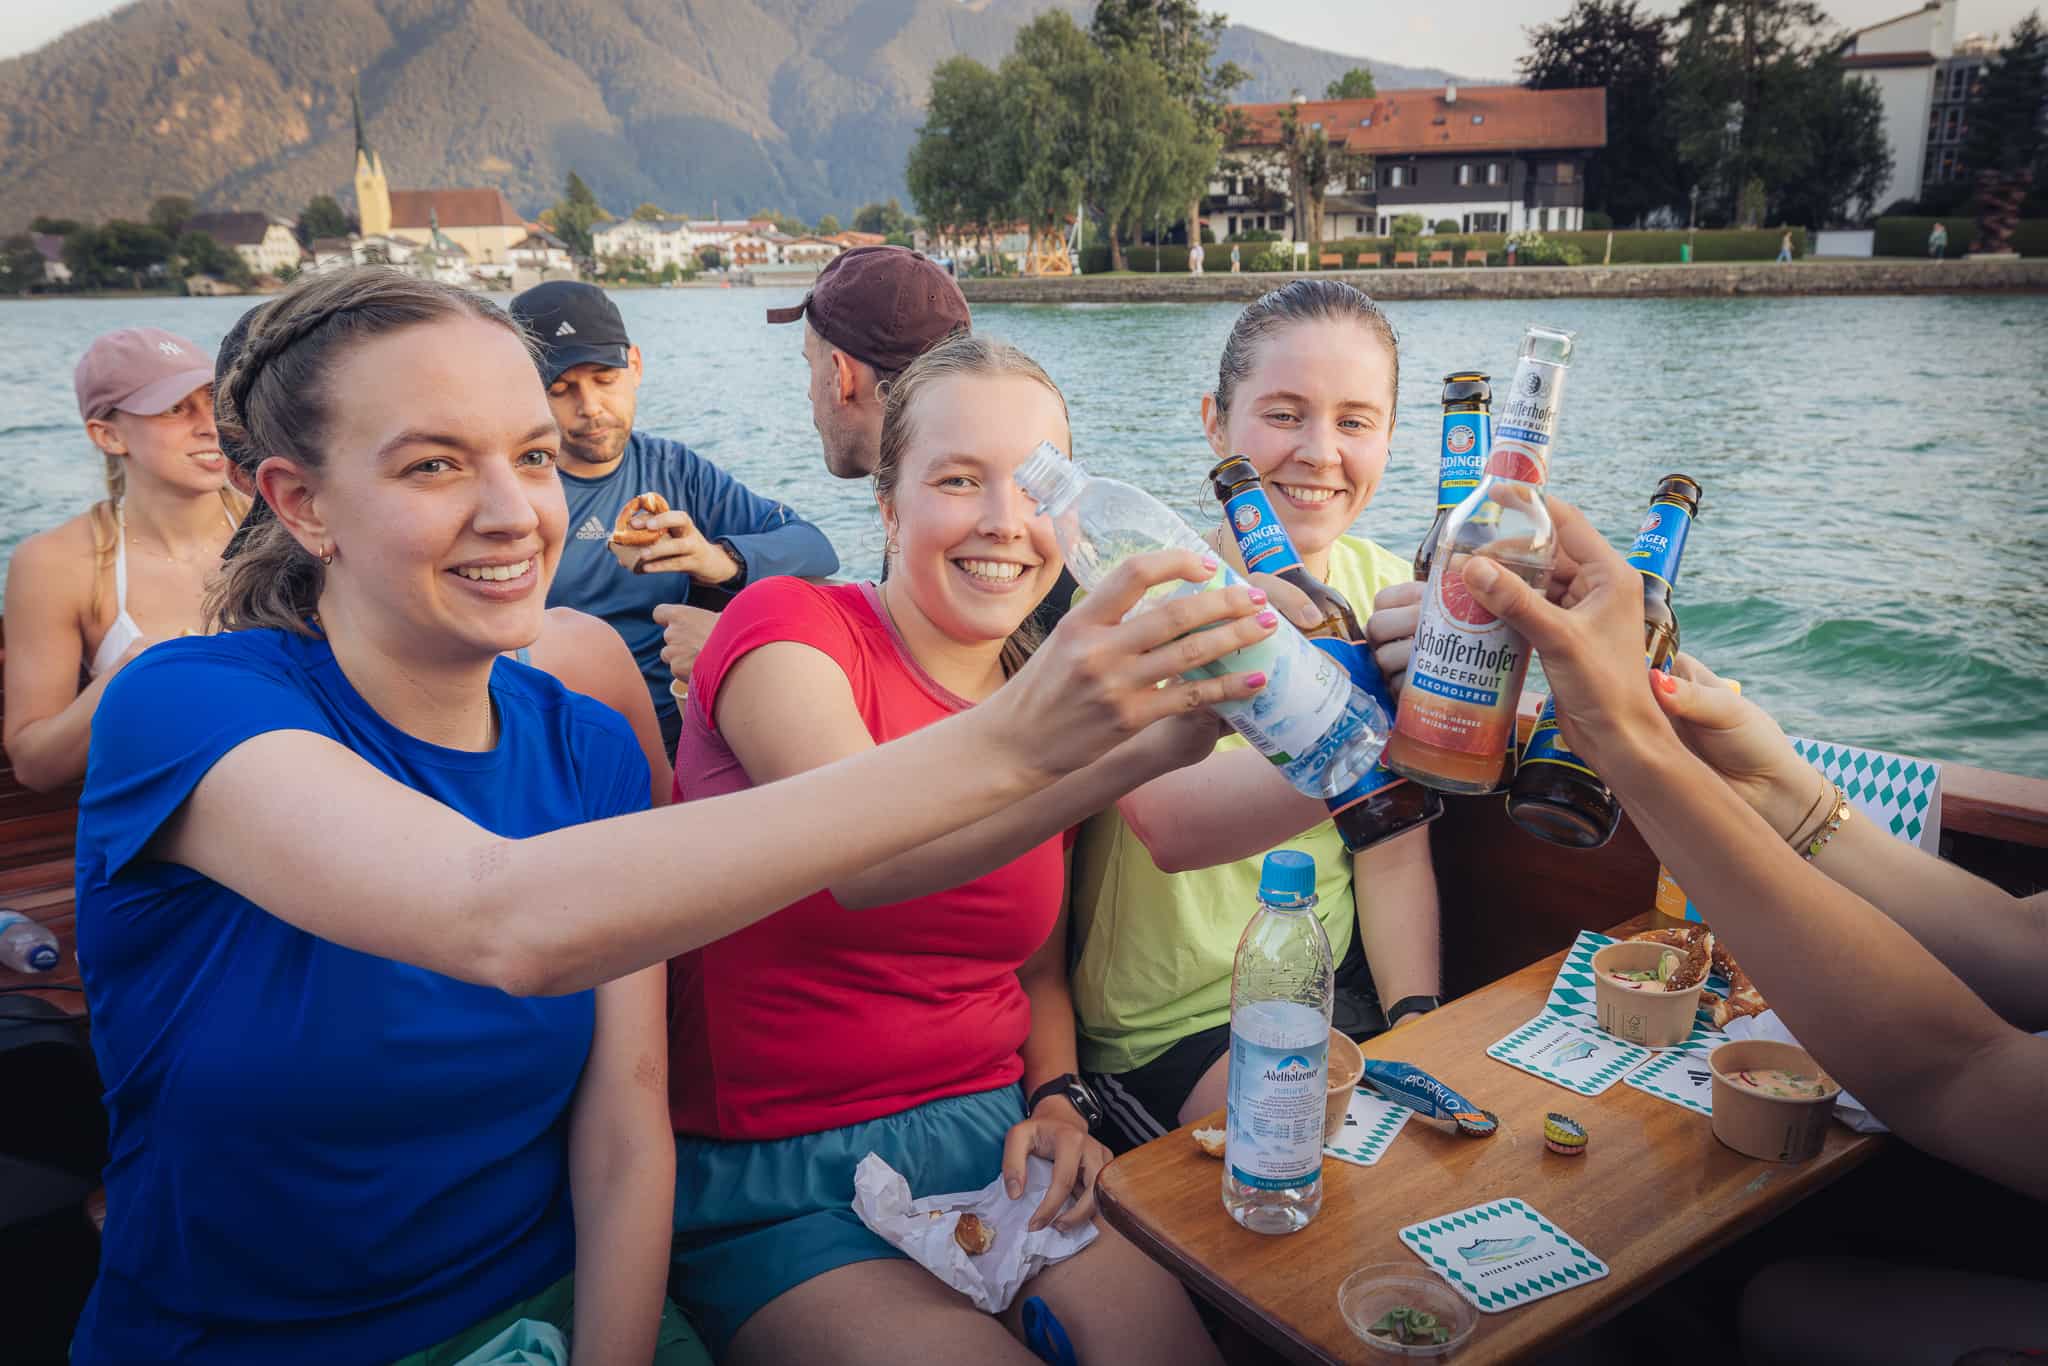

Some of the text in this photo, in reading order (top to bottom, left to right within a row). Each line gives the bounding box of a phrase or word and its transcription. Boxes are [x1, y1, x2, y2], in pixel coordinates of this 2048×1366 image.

[1414, 620, 1519, 674] Schöfferhofer
[1417, 658, 1502, 689] GRAPEFRUIT
[1416, 677, 1492, 702] ALKOHOLFREI
